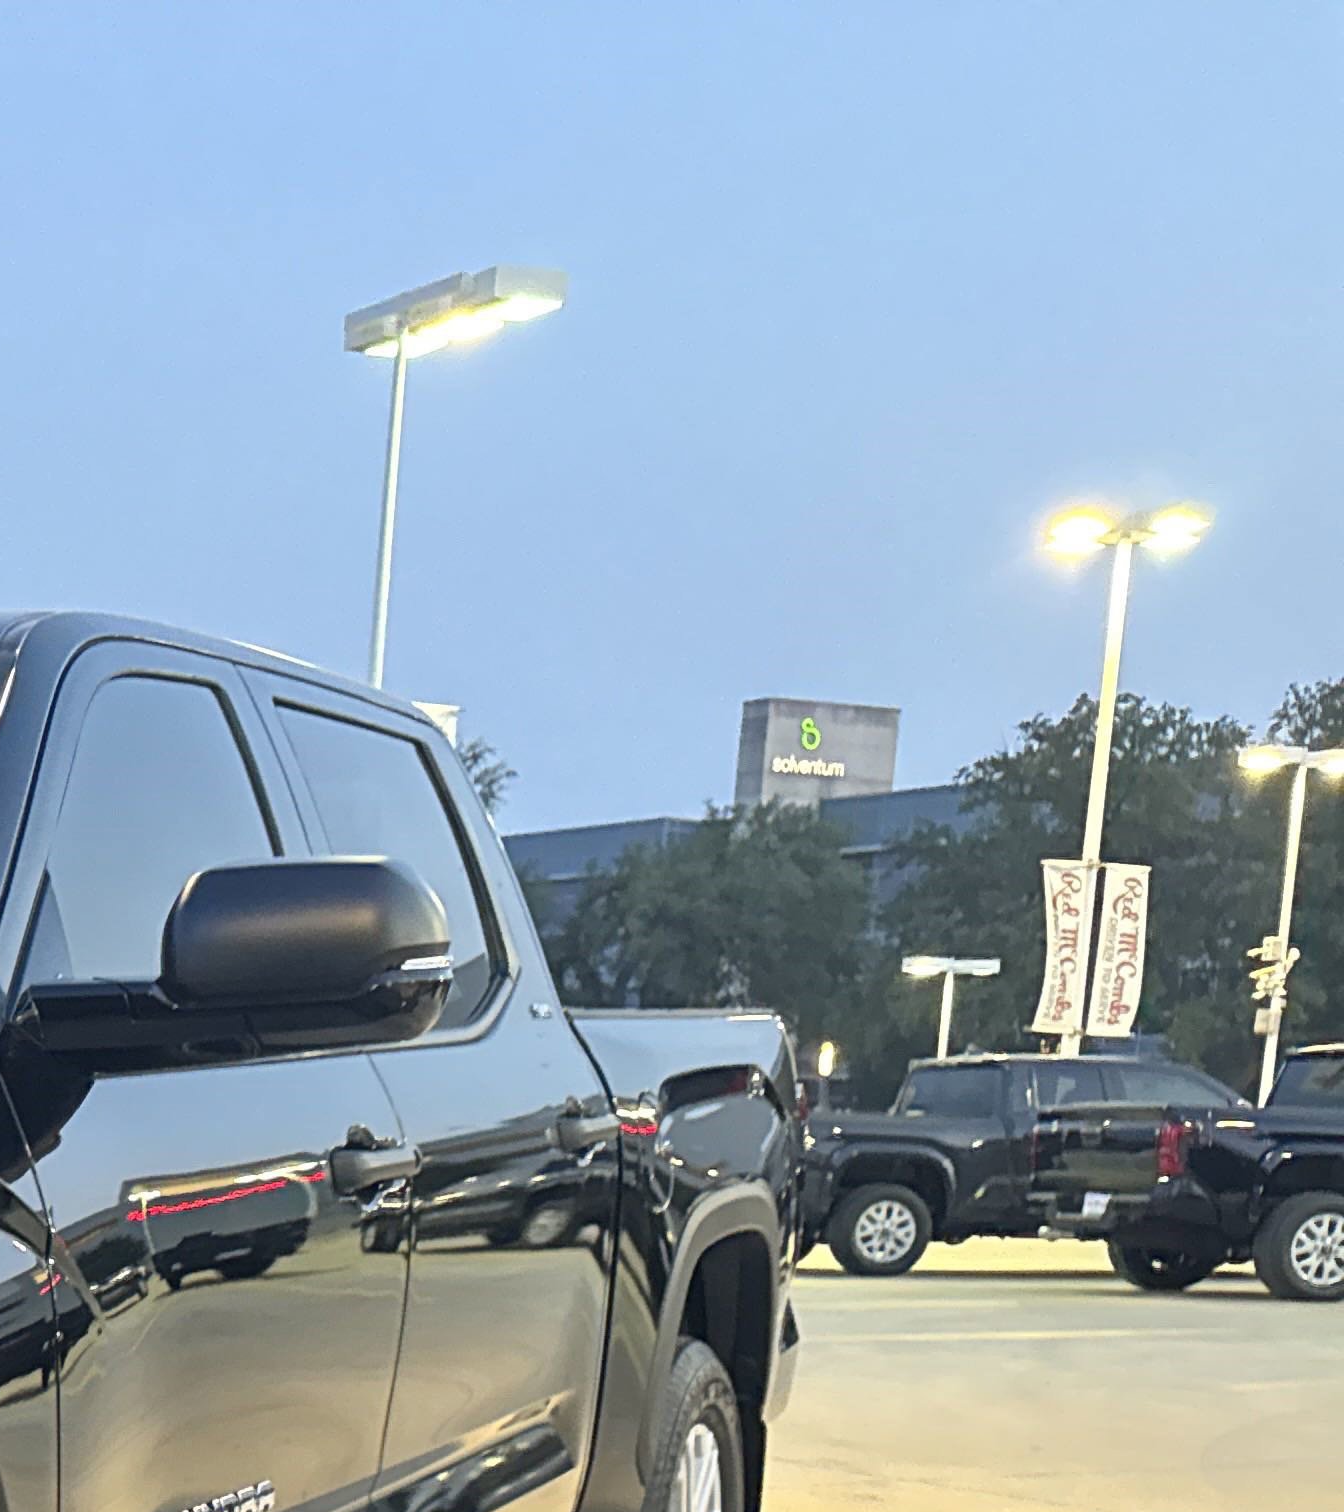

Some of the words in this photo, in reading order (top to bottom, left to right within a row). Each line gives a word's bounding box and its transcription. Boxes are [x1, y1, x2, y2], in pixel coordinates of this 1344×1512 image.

[772, 754, 845, 777] solventum
[1052, 871, 1082, 918] Red
[1112, 876, 1144, 923] Red
